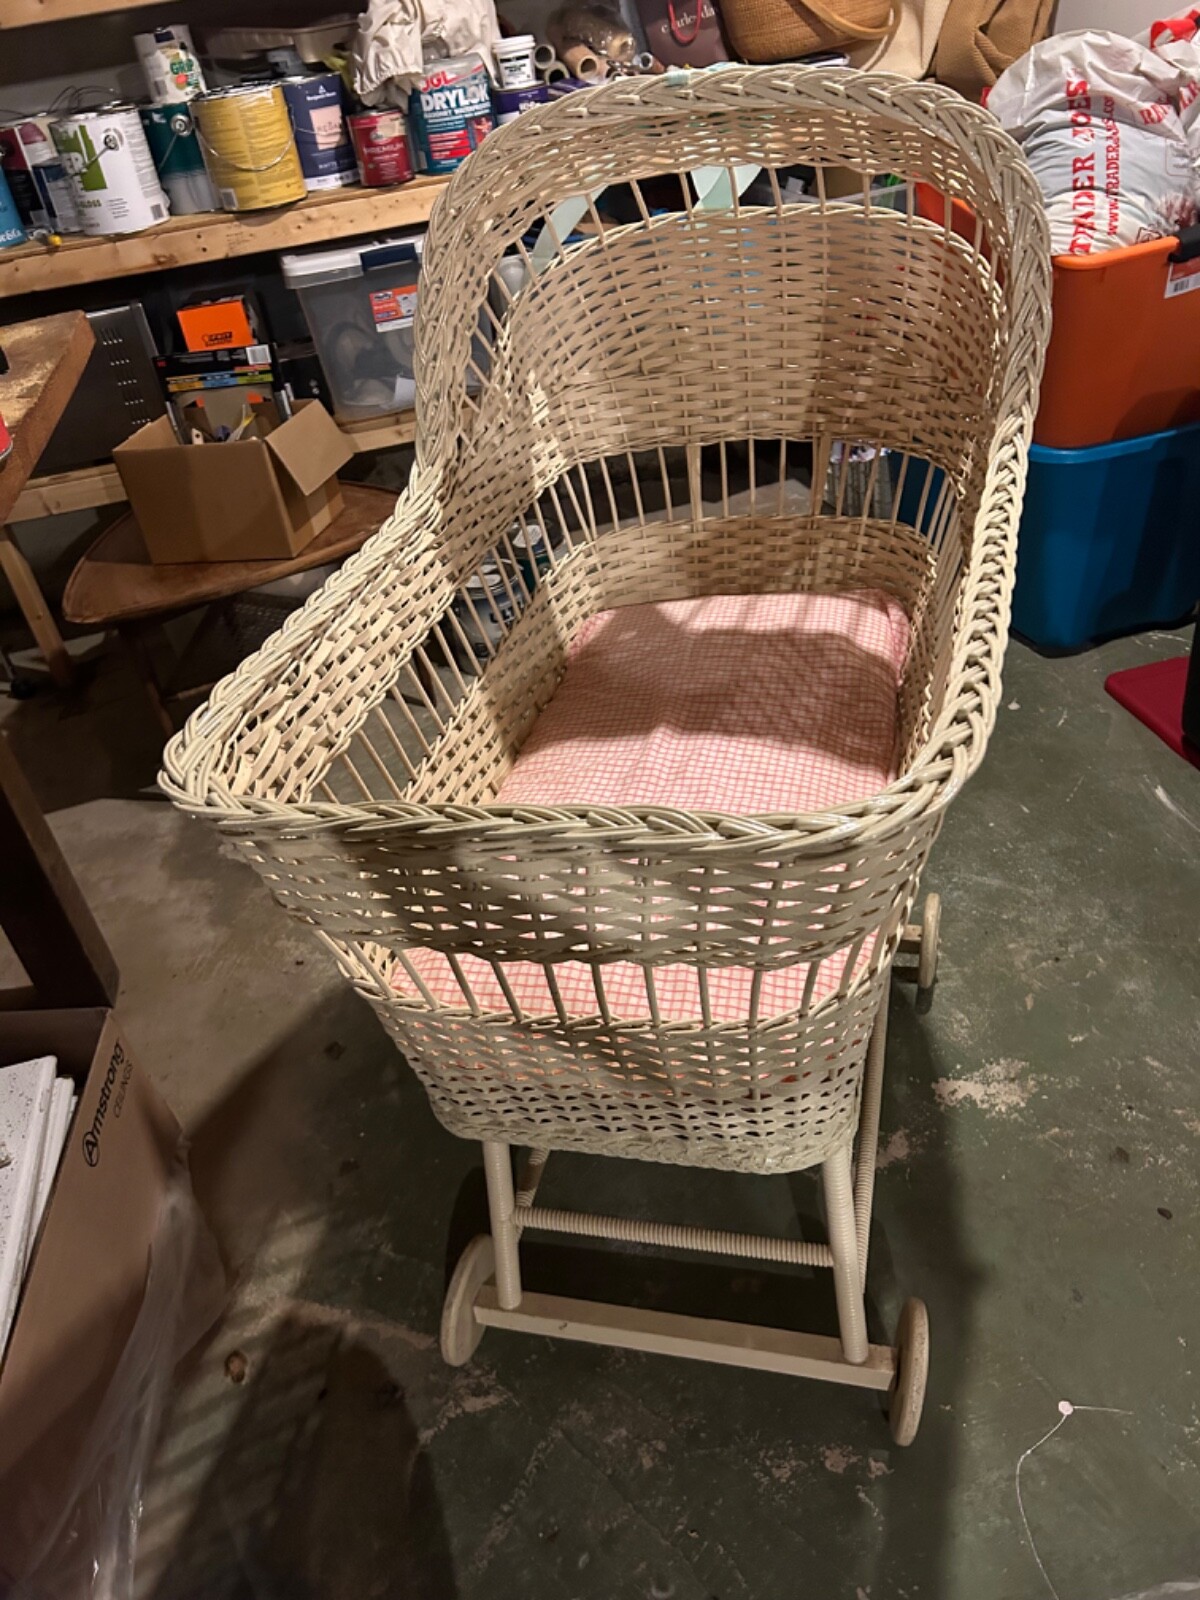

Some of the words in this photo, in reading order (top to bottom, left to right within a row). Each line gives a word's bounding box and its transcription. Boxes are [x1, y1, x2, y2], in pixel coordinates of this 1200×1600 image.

[420, 83, 490, 111] DRYLOK
[1069, 152, 1096, 257] TRADER
[82, 1039, 124, 1168] Armstrong
[113, 1060, 134, 1118] CEILINGS
